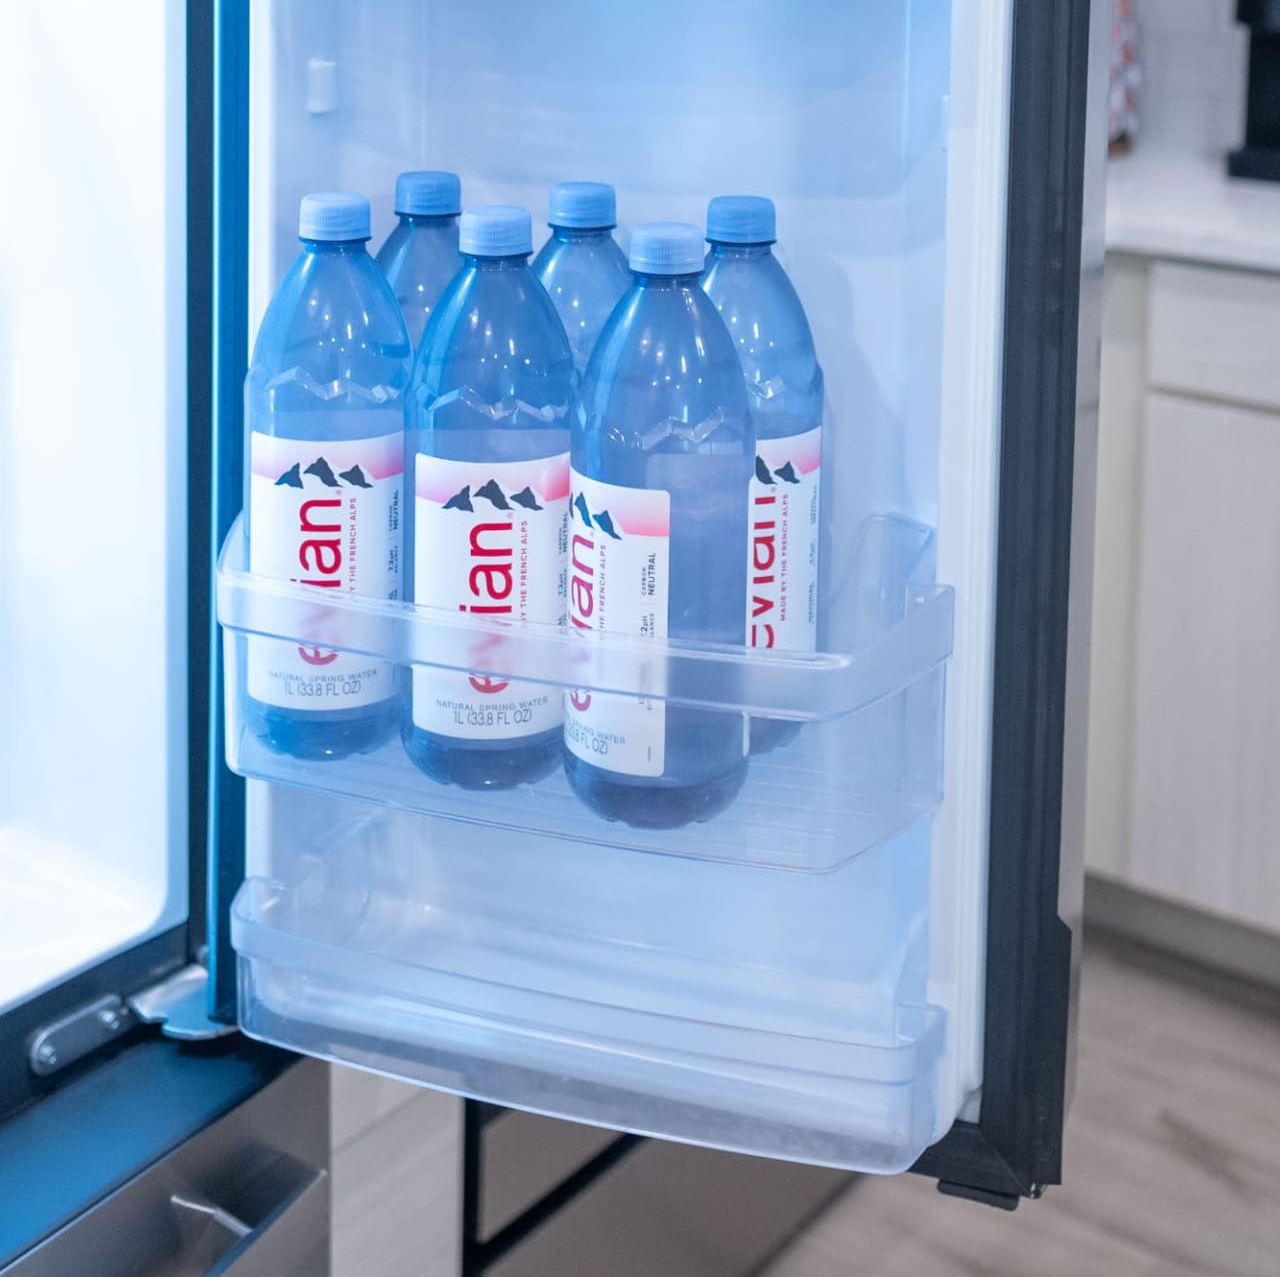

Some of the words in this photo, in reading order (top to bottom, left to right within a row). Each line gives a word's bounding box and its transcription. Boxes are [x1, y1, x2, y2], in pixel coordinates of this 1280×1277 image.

[348, 496, 358, 521] ALPS
[348, 524, 358, 562] FRENCH
[520, 519, 528, 545] ALPS
[520, 547, 528, 588] FRENCH
[599, 544, 607, 571] ALPS
[289, 498, 342, 666] eian
[647, 551, 657, 597] NEUTRAL
[781, 579, 787, 594] BY
[459, 522, 513, 694] eian
[520, 589, 528, 609] THE
[569, 533, 595, 712] eian
[268, 669, 304, 683] NATURAL
[309, 672, 344, 683] SPRING
[347, 668, 378, 681] WATER
[283, 681, 295, 696] 1L
[297, 681, 324, 698] (33.8
[325, 681, 340, 697] FL
[341, 679, 363, 695] OZ)
[435, 698, 475, 712] NATURAL
[478, 703, 516, 712] SPRING
[519, 695, 549, 709] WATER
[453, 710, 465, 725] 1L
[466, 710, 494, 726] (33.8
[496, 710, 511, 725] FL
[513, 708, 533, 724] OZ)
[592, 737, 608, 755] OZ)
